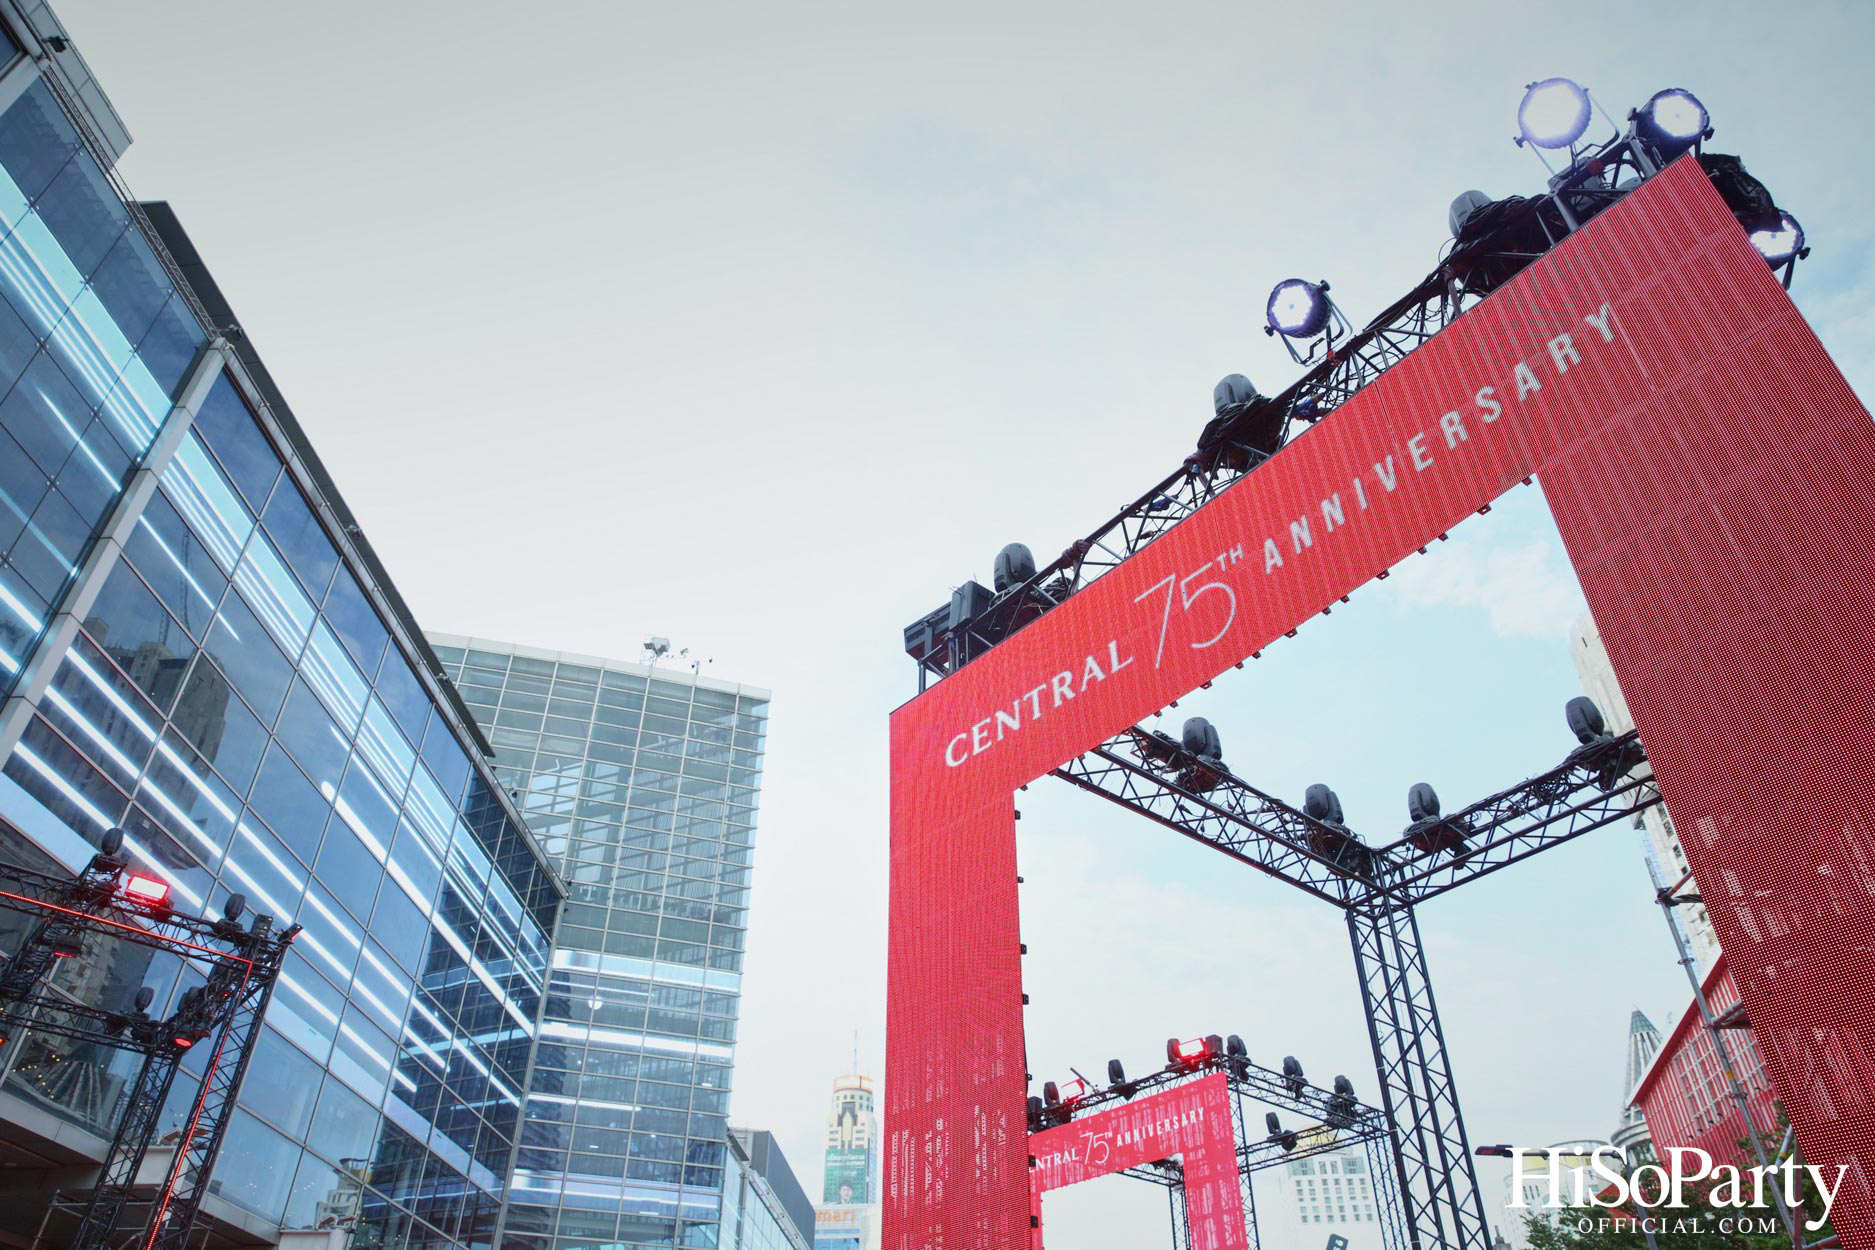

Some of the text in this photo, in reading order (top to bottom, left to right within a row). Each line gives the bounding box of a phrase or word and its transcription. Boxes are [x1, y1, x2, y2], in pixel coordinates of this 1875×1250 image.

[945, 639, 1134, 768] CENTRAL
[1263, 301, 1614, 575] ANNIVERSARY
[1116, 1107, 1205, 1147] ANNIVERSARY
